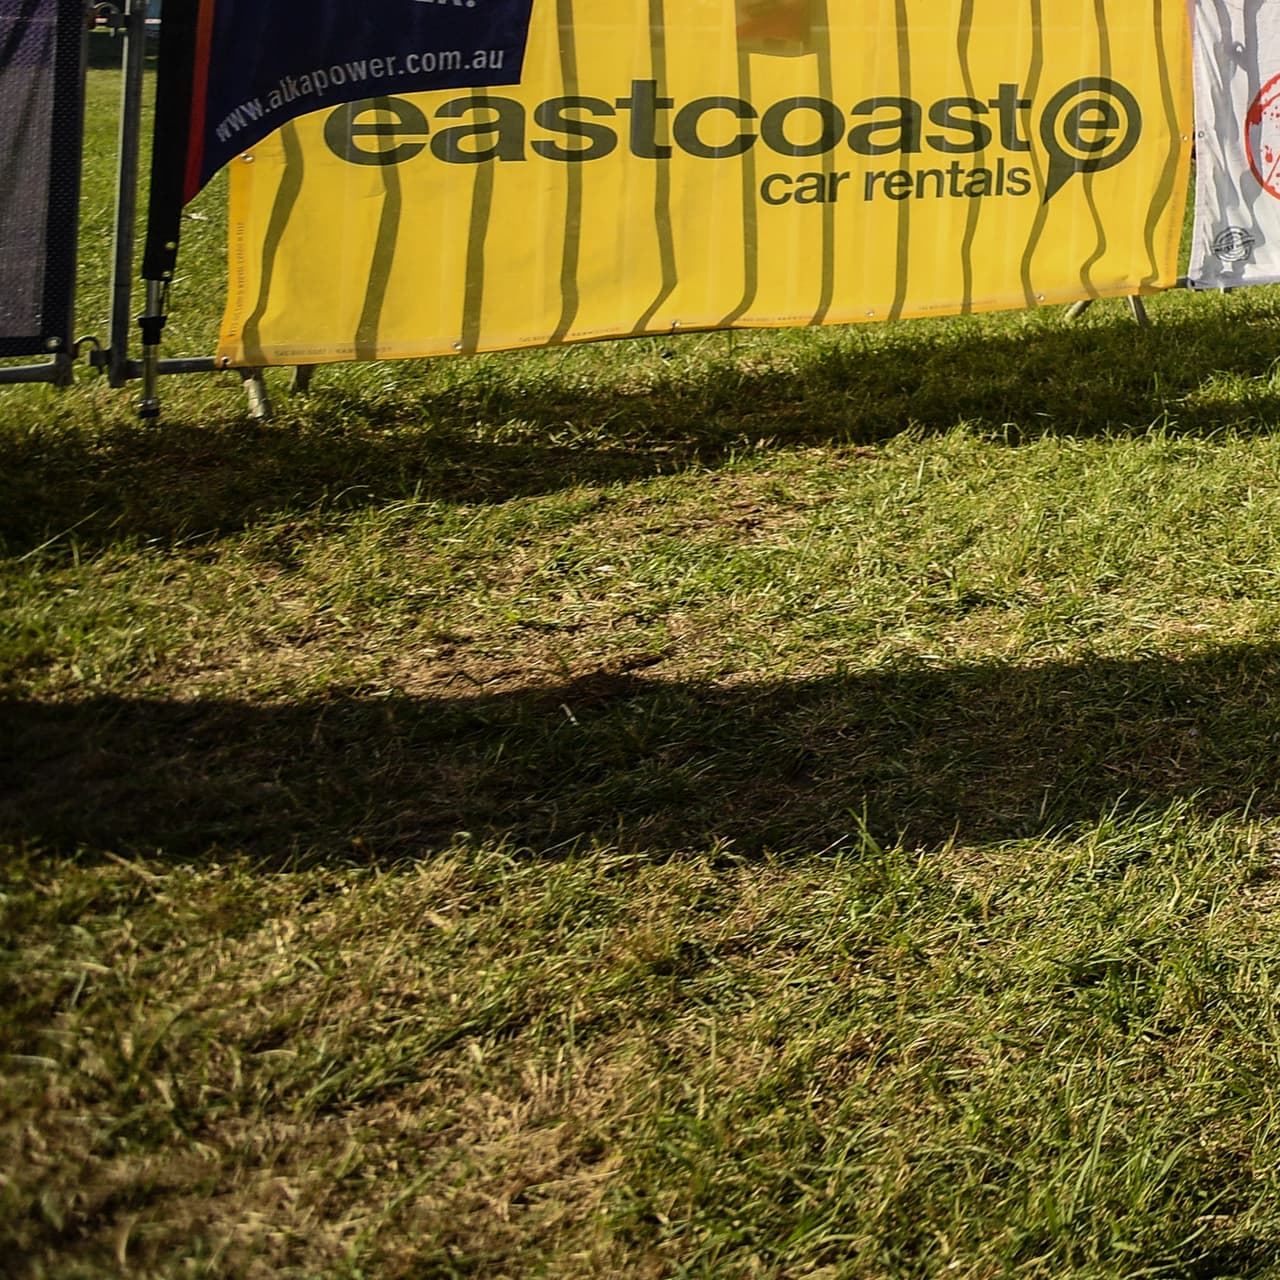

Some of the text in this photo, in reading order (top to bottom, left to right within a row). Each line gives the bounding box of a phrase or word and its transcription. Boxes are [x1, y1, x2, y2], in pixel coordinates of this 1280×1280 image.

[215, 48, 505, 142] www.alkapower.com.au
[323, 78, 1032, 167] eastcoast
[760, 157, 1031, 205] car rentals
